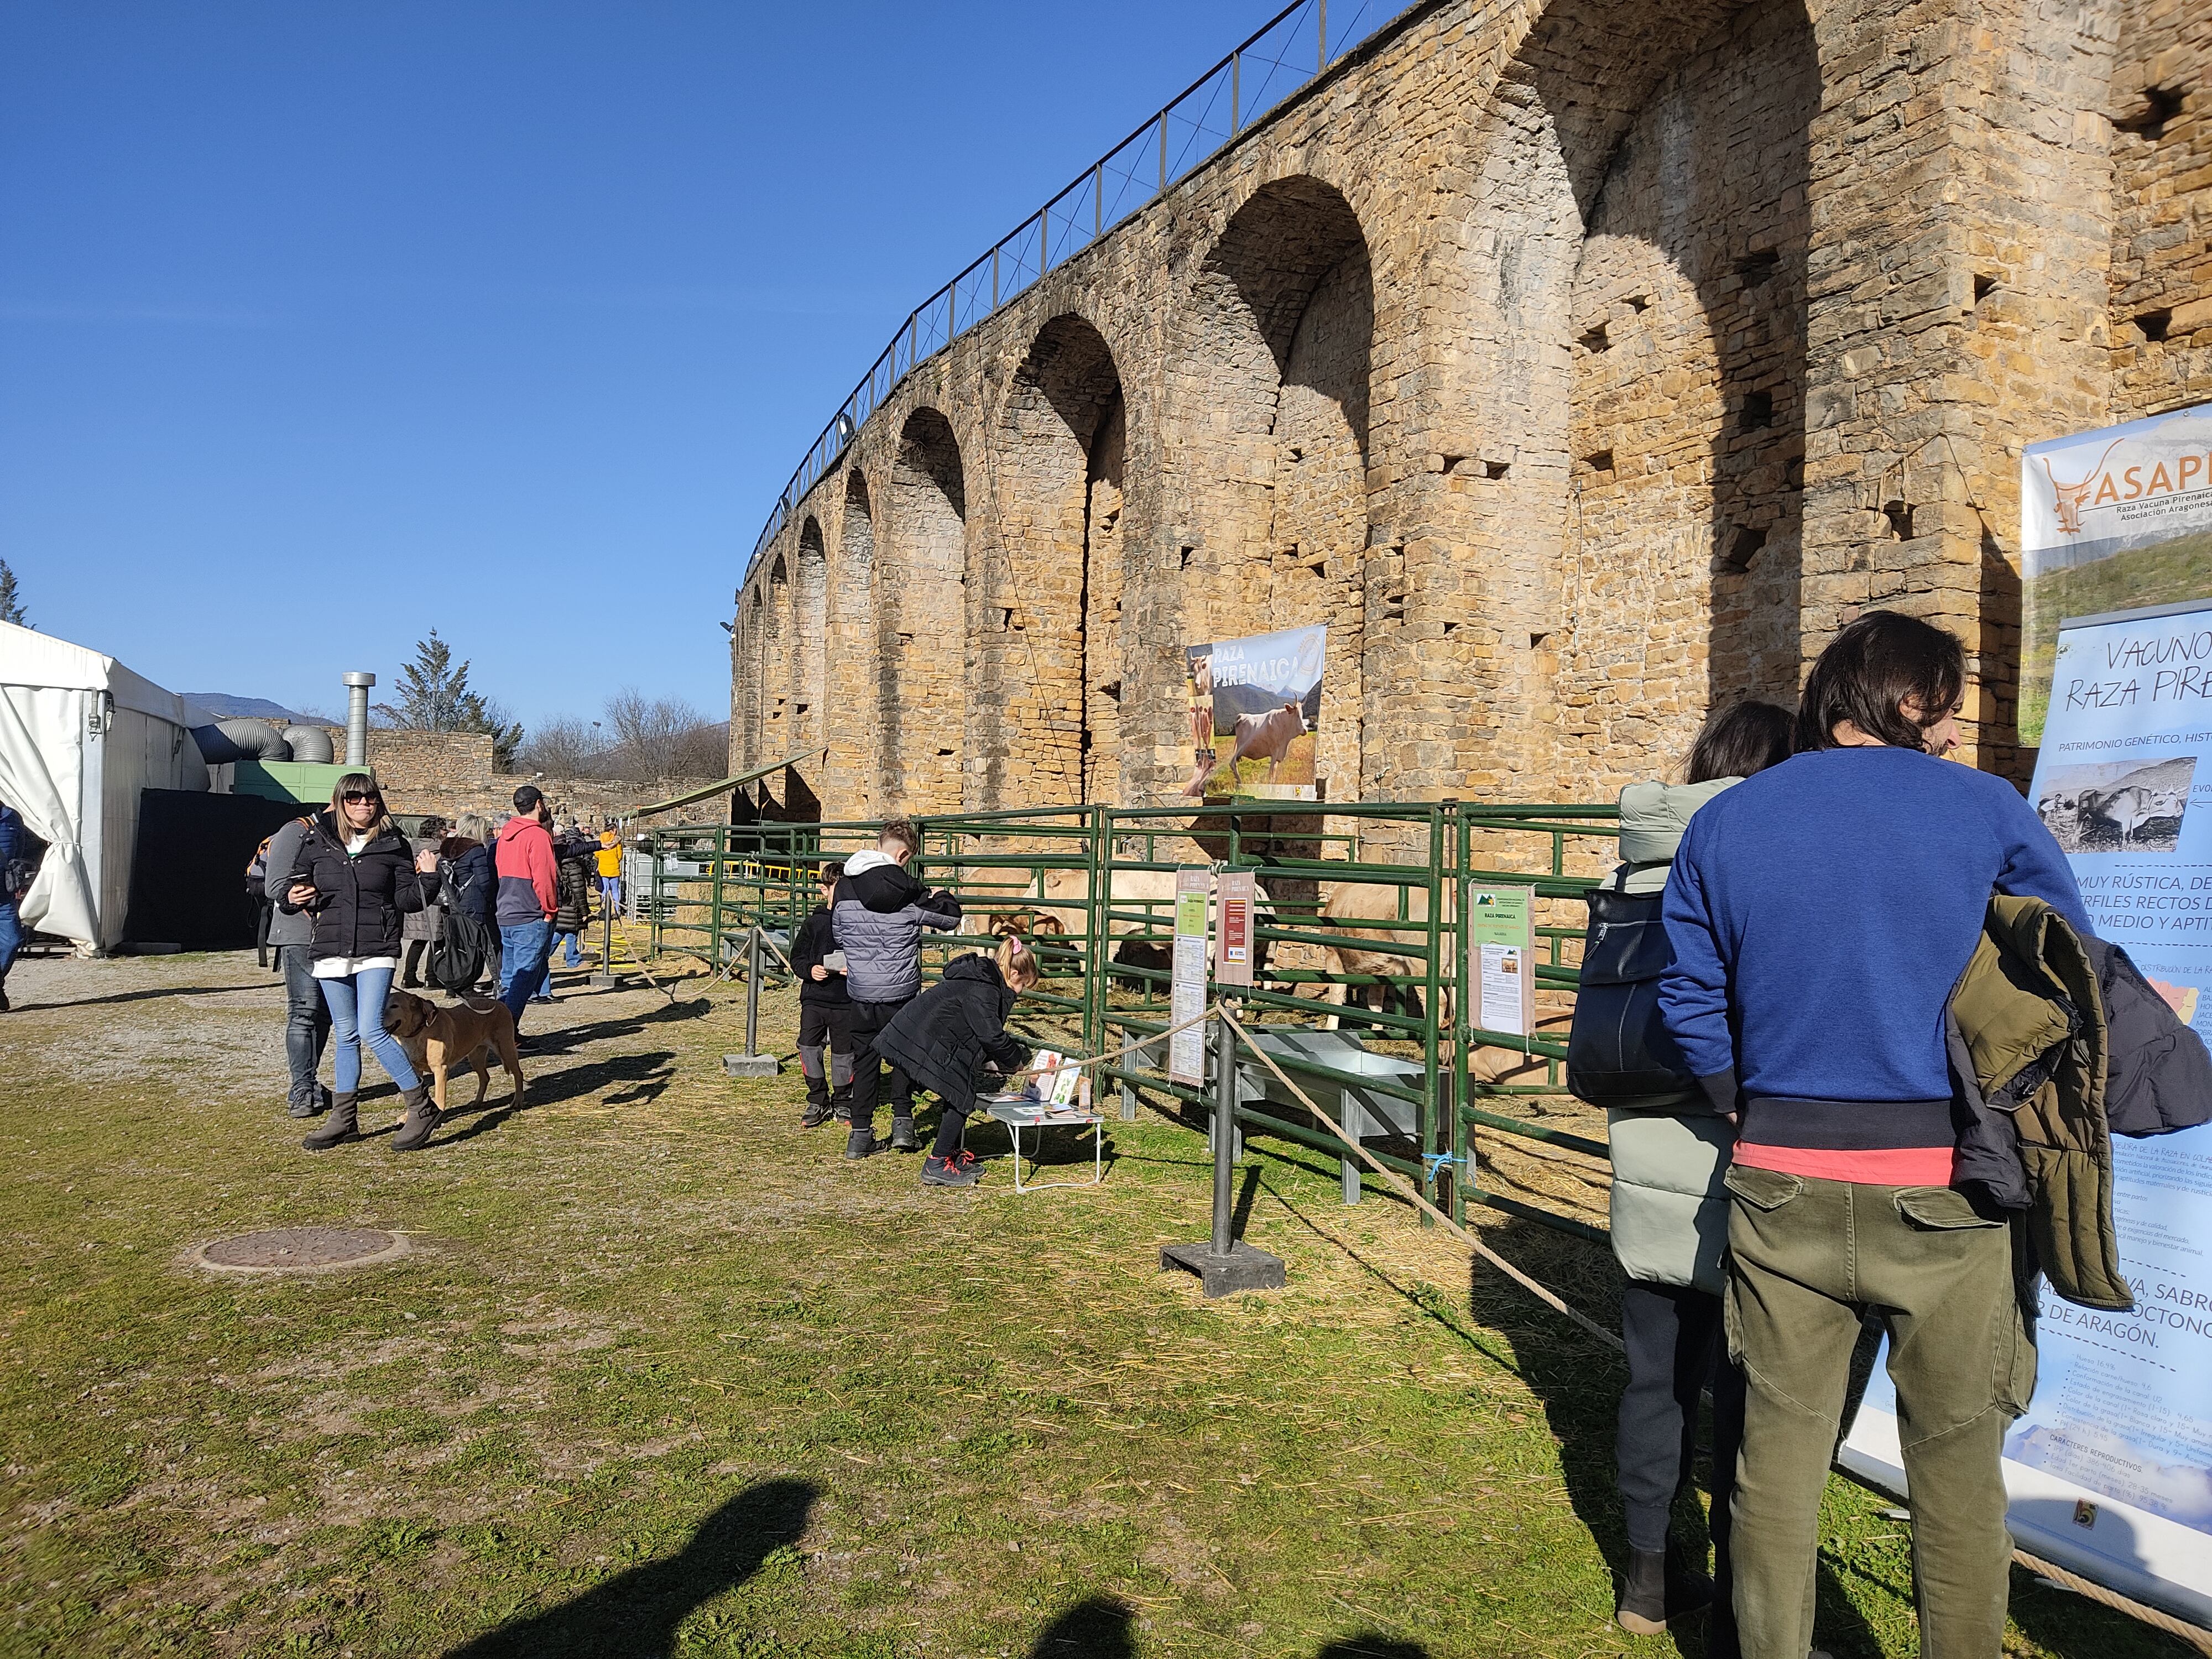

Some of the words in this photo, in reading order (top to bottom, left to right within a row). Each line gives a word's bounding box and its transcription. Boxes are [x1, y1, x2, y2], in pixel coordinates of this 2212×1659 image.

[2139, 499, 2169, 509] Vacuna
[2121, 508, 2166, 521] Asociación
[1214, 644, 1244, 663] RAZA
[2107, 631, 2212, 669] VACUNO
[1213, 656, 1298, 688] PIRENAICA
[2066, 678, 2141, 712] RAZA
[2058, 739, 2122, 752] PATRIMONIO
[2125, 733, 2182, 747] GENÉTICO,
[2185, 732, 2212, 743] HIST
[2077, 876, 2110, 889] MUY
[2112, 873, 2184, 891] RÚSTICA,
[2080, 895, 2132, 907] RFILES
[2136, 896, 2201, 910] RECTOS
[2099, 914, 2153, 928] MEDIO
[2159, 917, 2170, 930] Y
[2171, 917, 2212, 930] APTI
[2161, 1147, 2178, 1157] RAZA
[2149, 1164, 2176, 1173] valoración
[2152, 1173, 2183, 1182] priorizando
[2119, 1175, 2145, 1185] aptitudes
[2146, 1180, 2176, 1190] maternales
[2127, 1235, 2147, 1245] manejo
[2152, 1239, 2179, 1250] bienestar
[2180, 1245, 2204, 1257] animal.
[2163, 1234, 2190, 1244] mercado.
[2154, 1284, 2212, 1312] SABR
[2049, 1305, 2074, 1324] DE
[2076, 1313, 2159, 1349] ARAGÓN.
[2074, 1361, 2099, 1374] Relación
[2076, 1353, 2095, 1364] Hueso
[2072, 1370, 2114, 1388] Conformación
[2070, 1378, 2090, 1390] Estado
[2102, 1390, 2146, 1408] engrasamiento
[2068, 1386, 2083, 1396] Color
[2103, 1399, 2119, 1408] canal
[2133, 1407, 2148, 1418] Rosa
[2151, 1414, 2167, 1424] claro
[2063, 1402, 2095, 1419] Distribución
[2141, 1428, 2166, 1442] Irregular
[2065, 1395, 2081, 1405] Color
[2129, 1416, 2150, 1428] Blanca
[2174, 1431, 2188, 1442] Muy
[2069, 1423, 2080, 1431] (24
[2061, 1411, 2099, 1430] Consistencia
[2148, 1440, 2163, 1452] Dura
[2050, 1434, 2089, 1453] CARACTERES
[2087, 1457, 2115, 1473] 386-406
[2049, 1461, 2063, 1472] Tasa
[2065, 1467, 2092, 1483] Facilidad
[2104, 1483, 2120, 1494] parto
[2122, 1489, 2135, 1500] (%)
[2161, 1503, 2168, 1512] %
[2051, 1453, 2067, 1464] Edad
[2079, 1465, 2097, 1475] parto
[2098, 1471, 2125, 1486] (meses)
[2128, 1481, 2150, 1495] 28-35
[2151, 1491, 2173, 1503] meses
